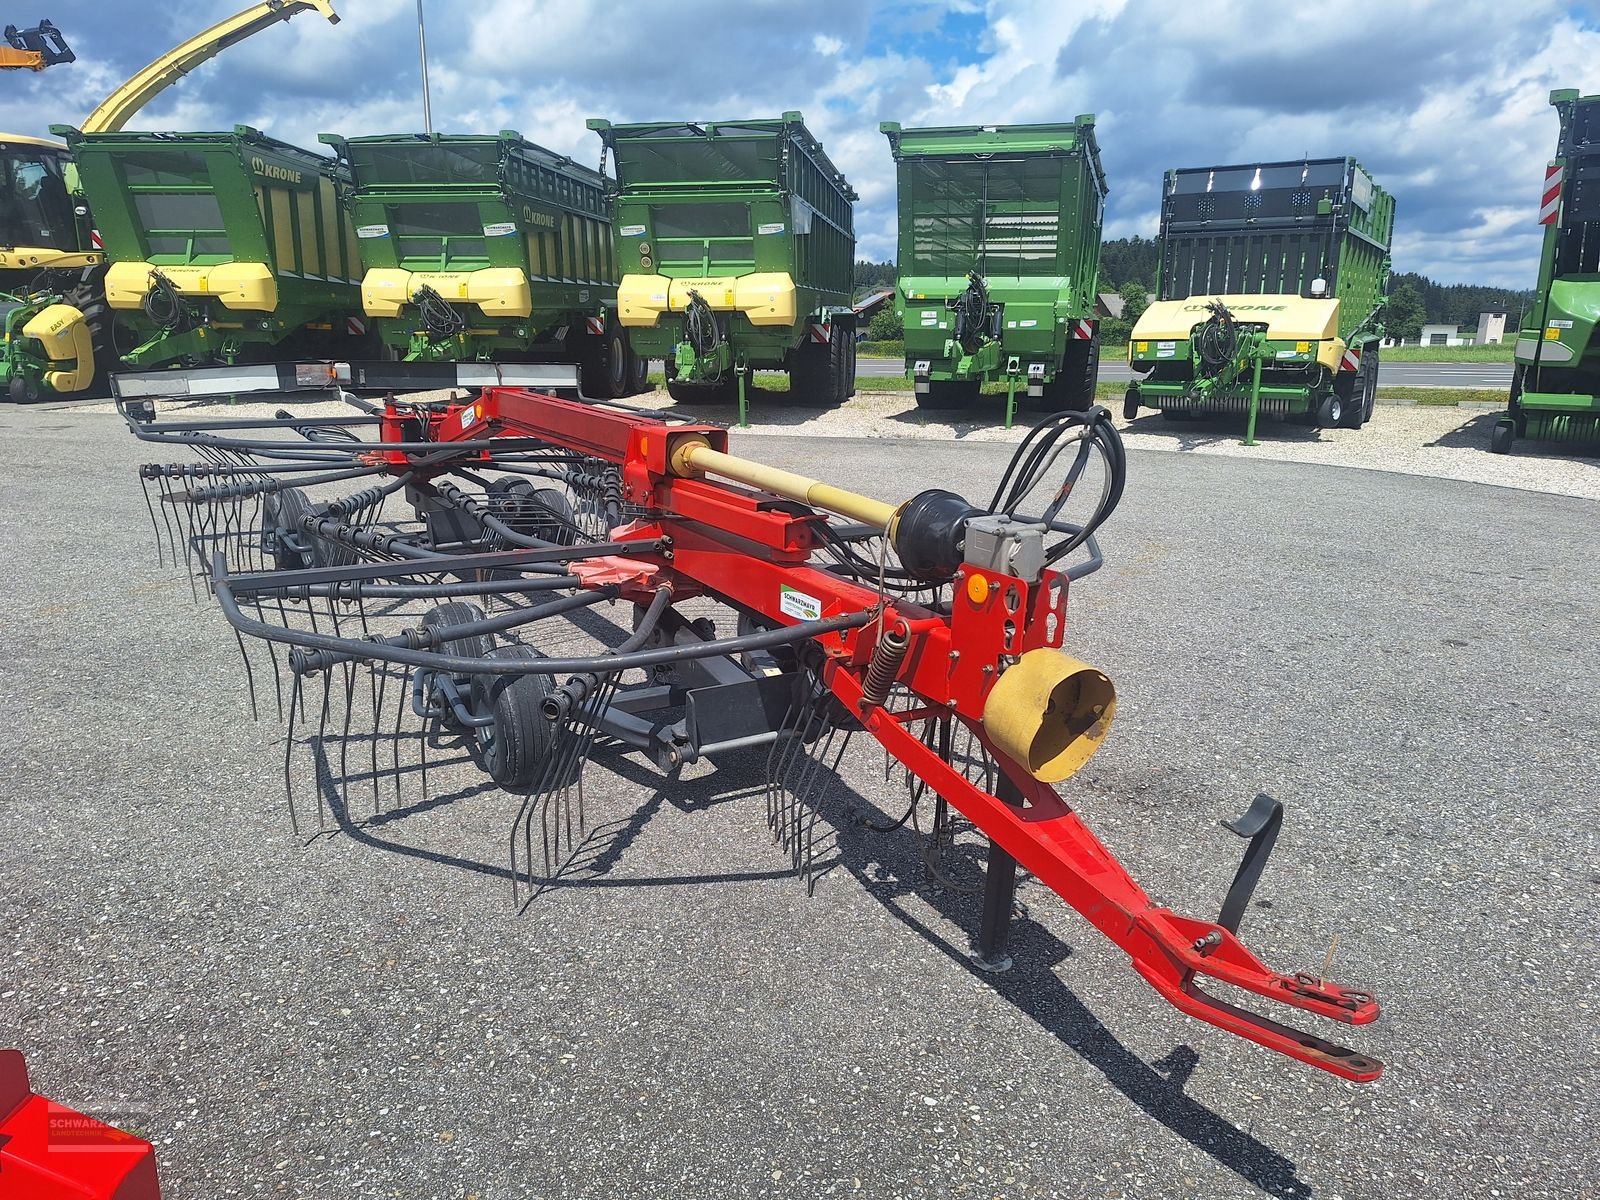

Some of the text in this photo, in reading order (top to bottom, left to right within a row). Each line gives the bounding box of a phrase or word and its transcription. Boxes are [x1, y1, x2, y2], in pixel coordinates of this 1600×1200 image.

[265, 164, 301, 184] KRONE
[531, 212, 555, 228] KRONE
[50, 319, 65, 332] EASY
[784, 592, 816, 610] SCHWARZMAYR
